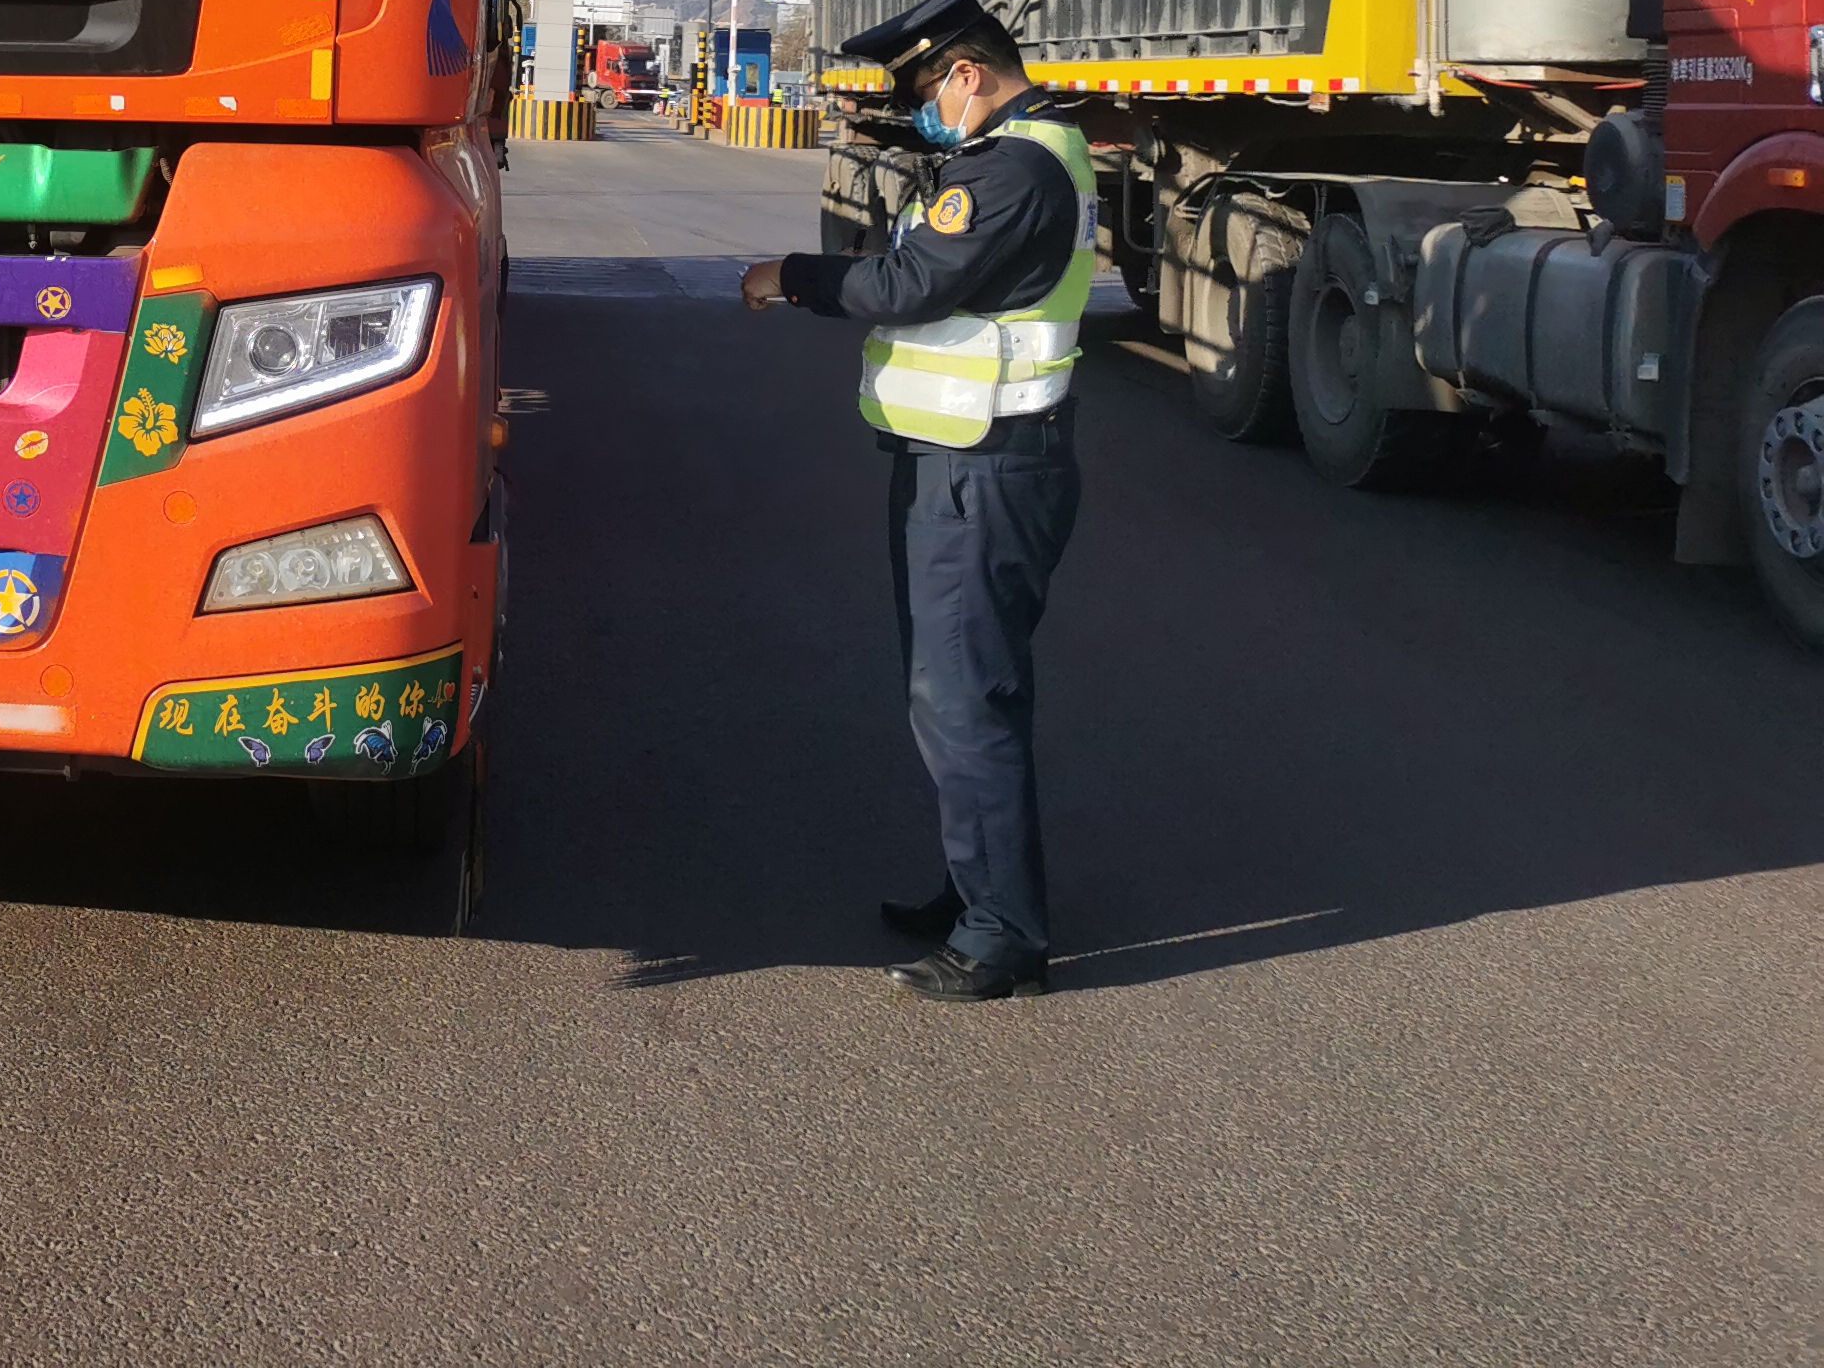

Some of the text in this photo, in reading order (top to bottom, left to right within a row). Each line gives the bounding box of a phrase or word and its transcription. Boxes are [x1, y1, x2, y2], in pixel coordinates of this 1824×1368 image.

[158, 679, 428, 737] 现在奋斗的你
